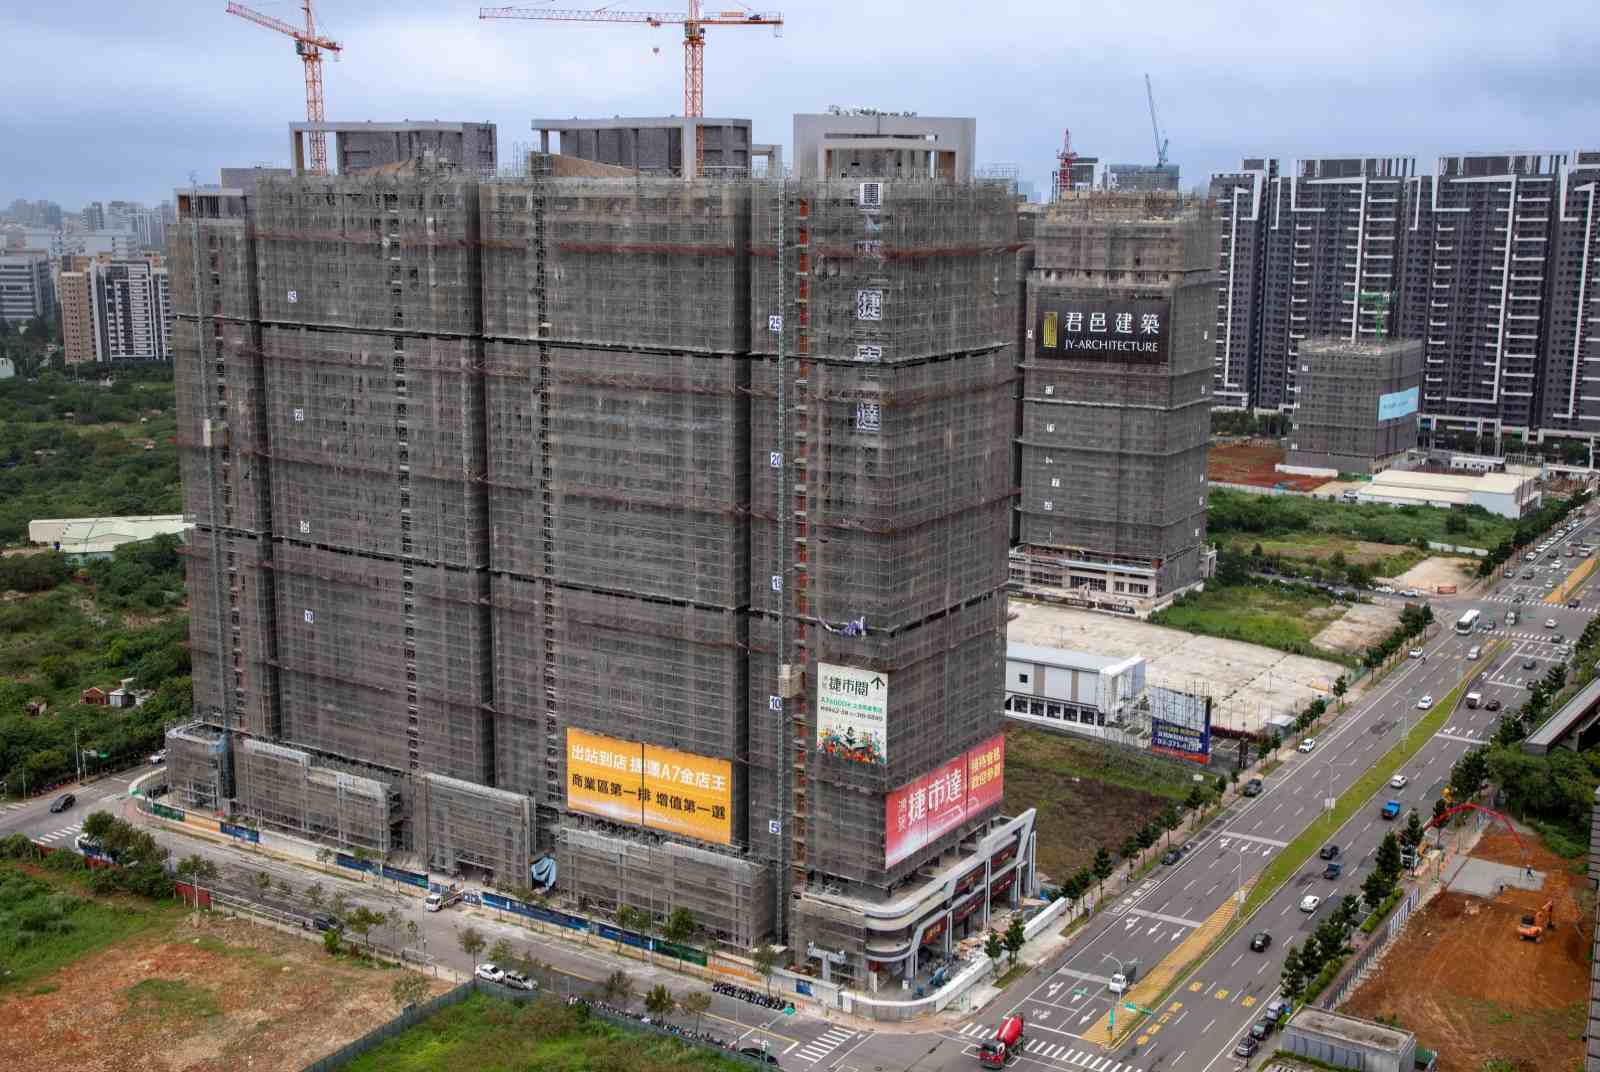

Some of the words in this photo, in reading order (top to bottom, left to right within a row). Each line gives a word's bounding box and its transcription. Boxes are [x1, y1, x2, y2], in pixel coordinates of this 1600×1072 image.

[769, 316, 782, 330] 25
[1064, 311, 1160, 334] 君邑建築
[771, 453, 782, 466] 20
[770, 696, 782, 709] 10
[571, 744, 627, 772] 出站到店
[572, 773, 651, 802] 商業區第一排
[908, 768, 962, 828] 捷市達
[770, 821, 781, 834] 5
